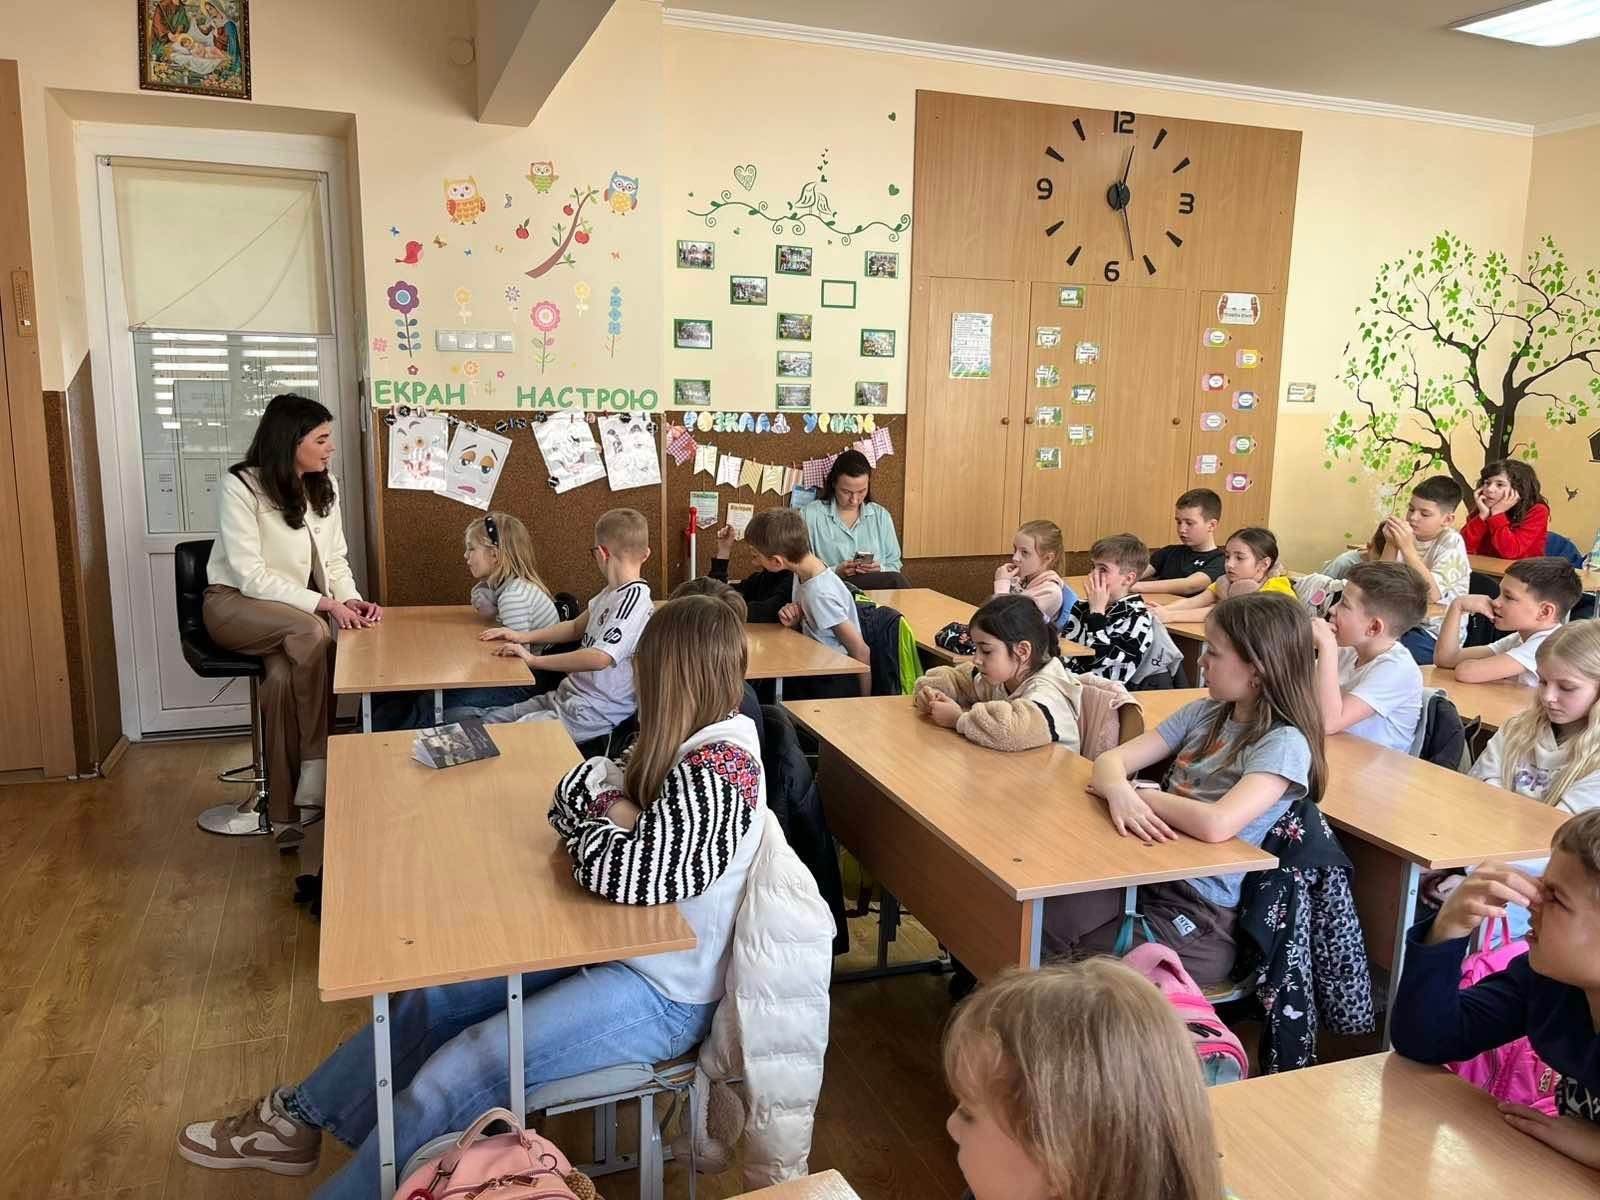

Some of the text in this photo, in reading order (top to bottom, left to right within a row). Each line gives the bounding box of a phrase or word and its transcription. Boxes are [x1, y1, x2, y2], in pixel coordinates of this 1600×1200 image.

[1113, 111, 1136, 134] 12
[1036, 178, 1053, 200] 9
[1178, 192, 1195, 215] 3
[1104, 260, 1120, 282] 6
[374, 380, 659, 410] ЕКРАН НАСТРОЮ
